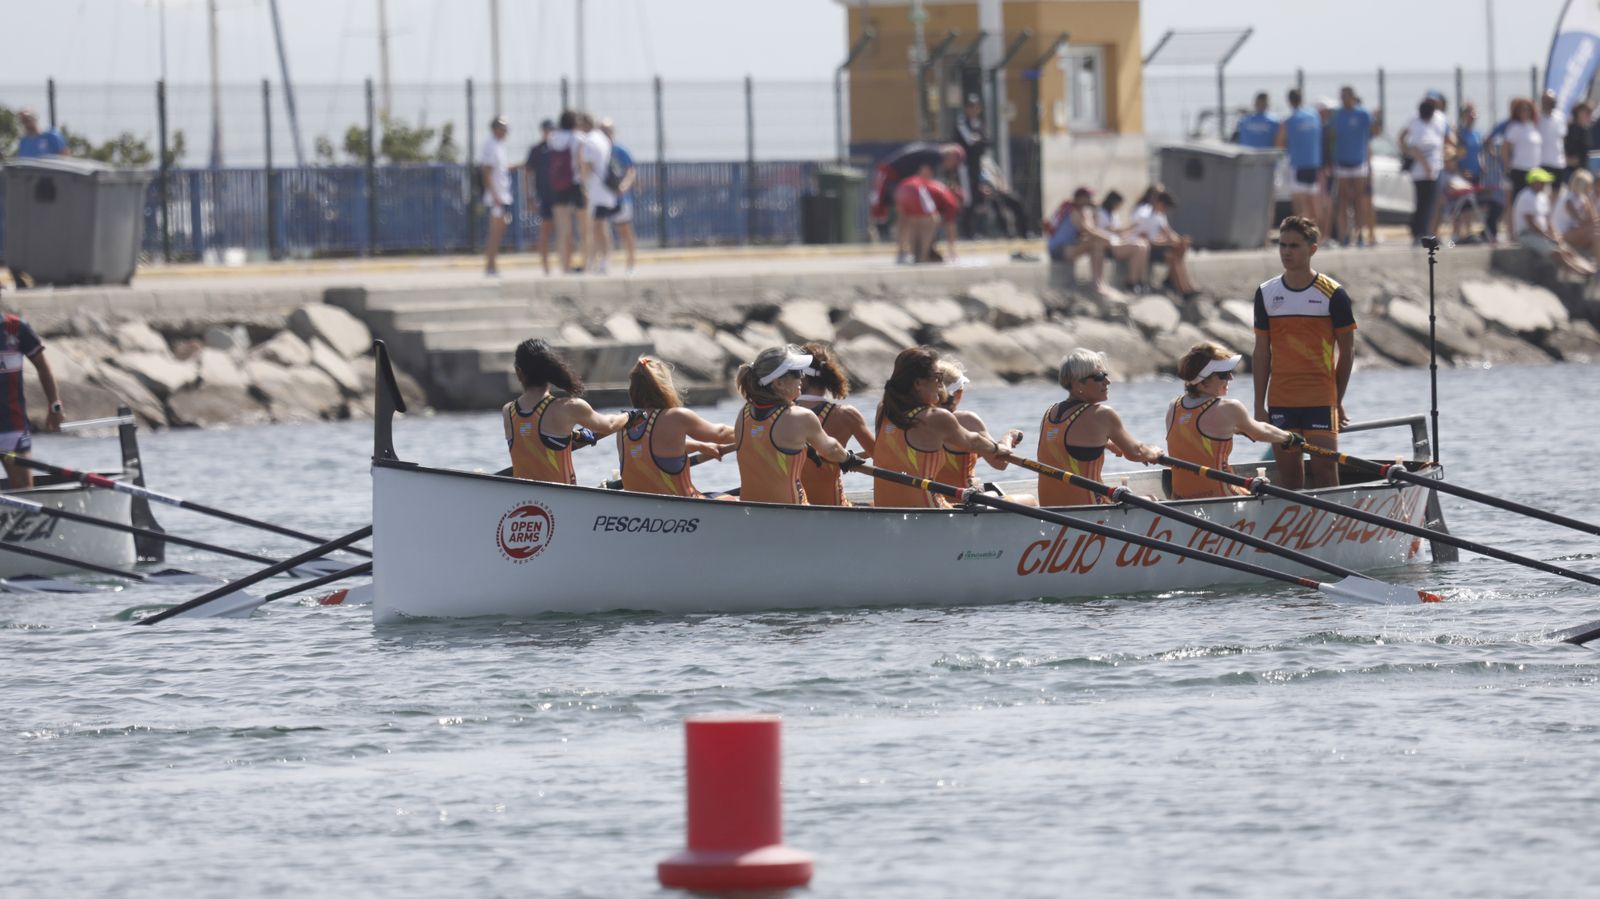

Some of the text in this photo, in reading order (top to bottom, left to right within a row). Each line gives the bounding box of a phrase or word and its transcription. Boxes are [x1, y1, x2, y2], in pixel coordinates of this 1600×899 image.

[510, 521, 543, 532] OPEN
[592, 515, 700, 534] PESCADORS
[508, 532, 540, 543] ARMS
[1017, 520, 1106, 577] club
[1115, 516, 1173, 568] de
